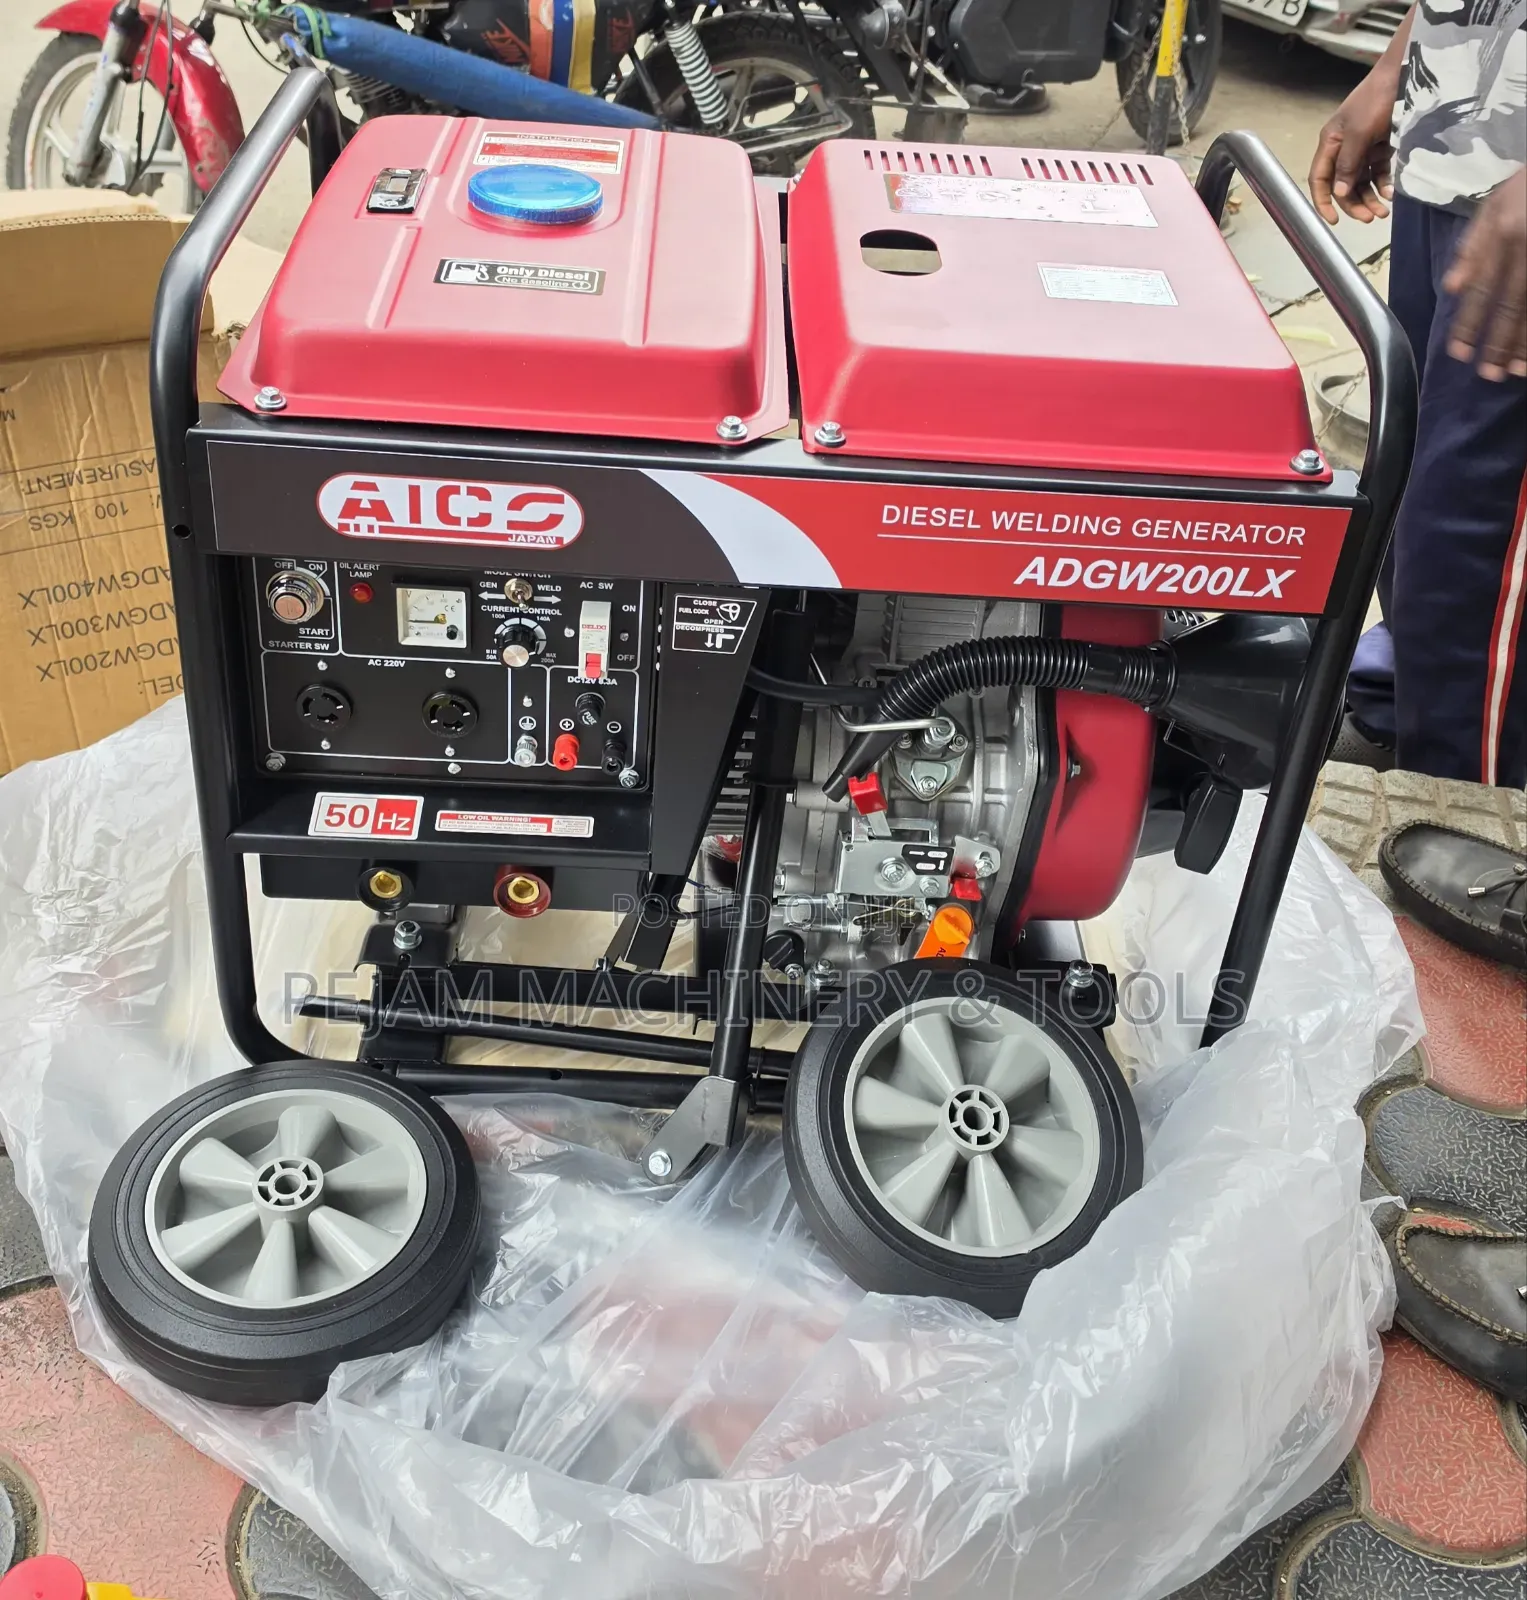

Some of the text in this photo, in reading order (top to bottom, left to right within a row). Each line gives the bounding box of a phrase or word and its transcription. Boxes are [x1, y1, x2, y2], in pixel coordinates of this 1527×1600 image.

[515, 133, 592, 144] INSTRUCTION
[496, 265, 590, 280] Only Diesel
[502, 276, 570, 288] No Gasoline
[94, 500, 129, 520] 100
[337, 480, 565, 533] AICS
[28, 508, 76, 532] KGS
[881, 504, 1306, 546] DIESEL WELDING GENERATOR
[507, 534, 556, 545] JAPAN
[274, 561, 293, 570] OFF
[308, 563, 323, 571] ON
[339, 562, 380, 571] OIL ALERT
[1014, 555, 1297, 599] ADGW200LX
[479, 581, 498, 589] GEN
[537, 584, 562, 592] WELD
[579, 581, 614, 590] AC SW
[693, 599, 718, 607] CLOSE
[481, 605, 520, 613] CURRENT
[621, 604, 636, 612] ON
[299, 627, 331, 636] START
[675, 624, 725, 633] DECOMPRESS
[268, 640, 330, 651] STARTER SW
[36, 637, 180, 682] DGW200LX
[616, 653, 636, 662] OFF
[367, 659, 406, 668] AC 220V
[583, 711, 598, 726] FUSE
[323, 803, 411, 831] 50 Hz
[491, 815, 532, 823] WARNING!
